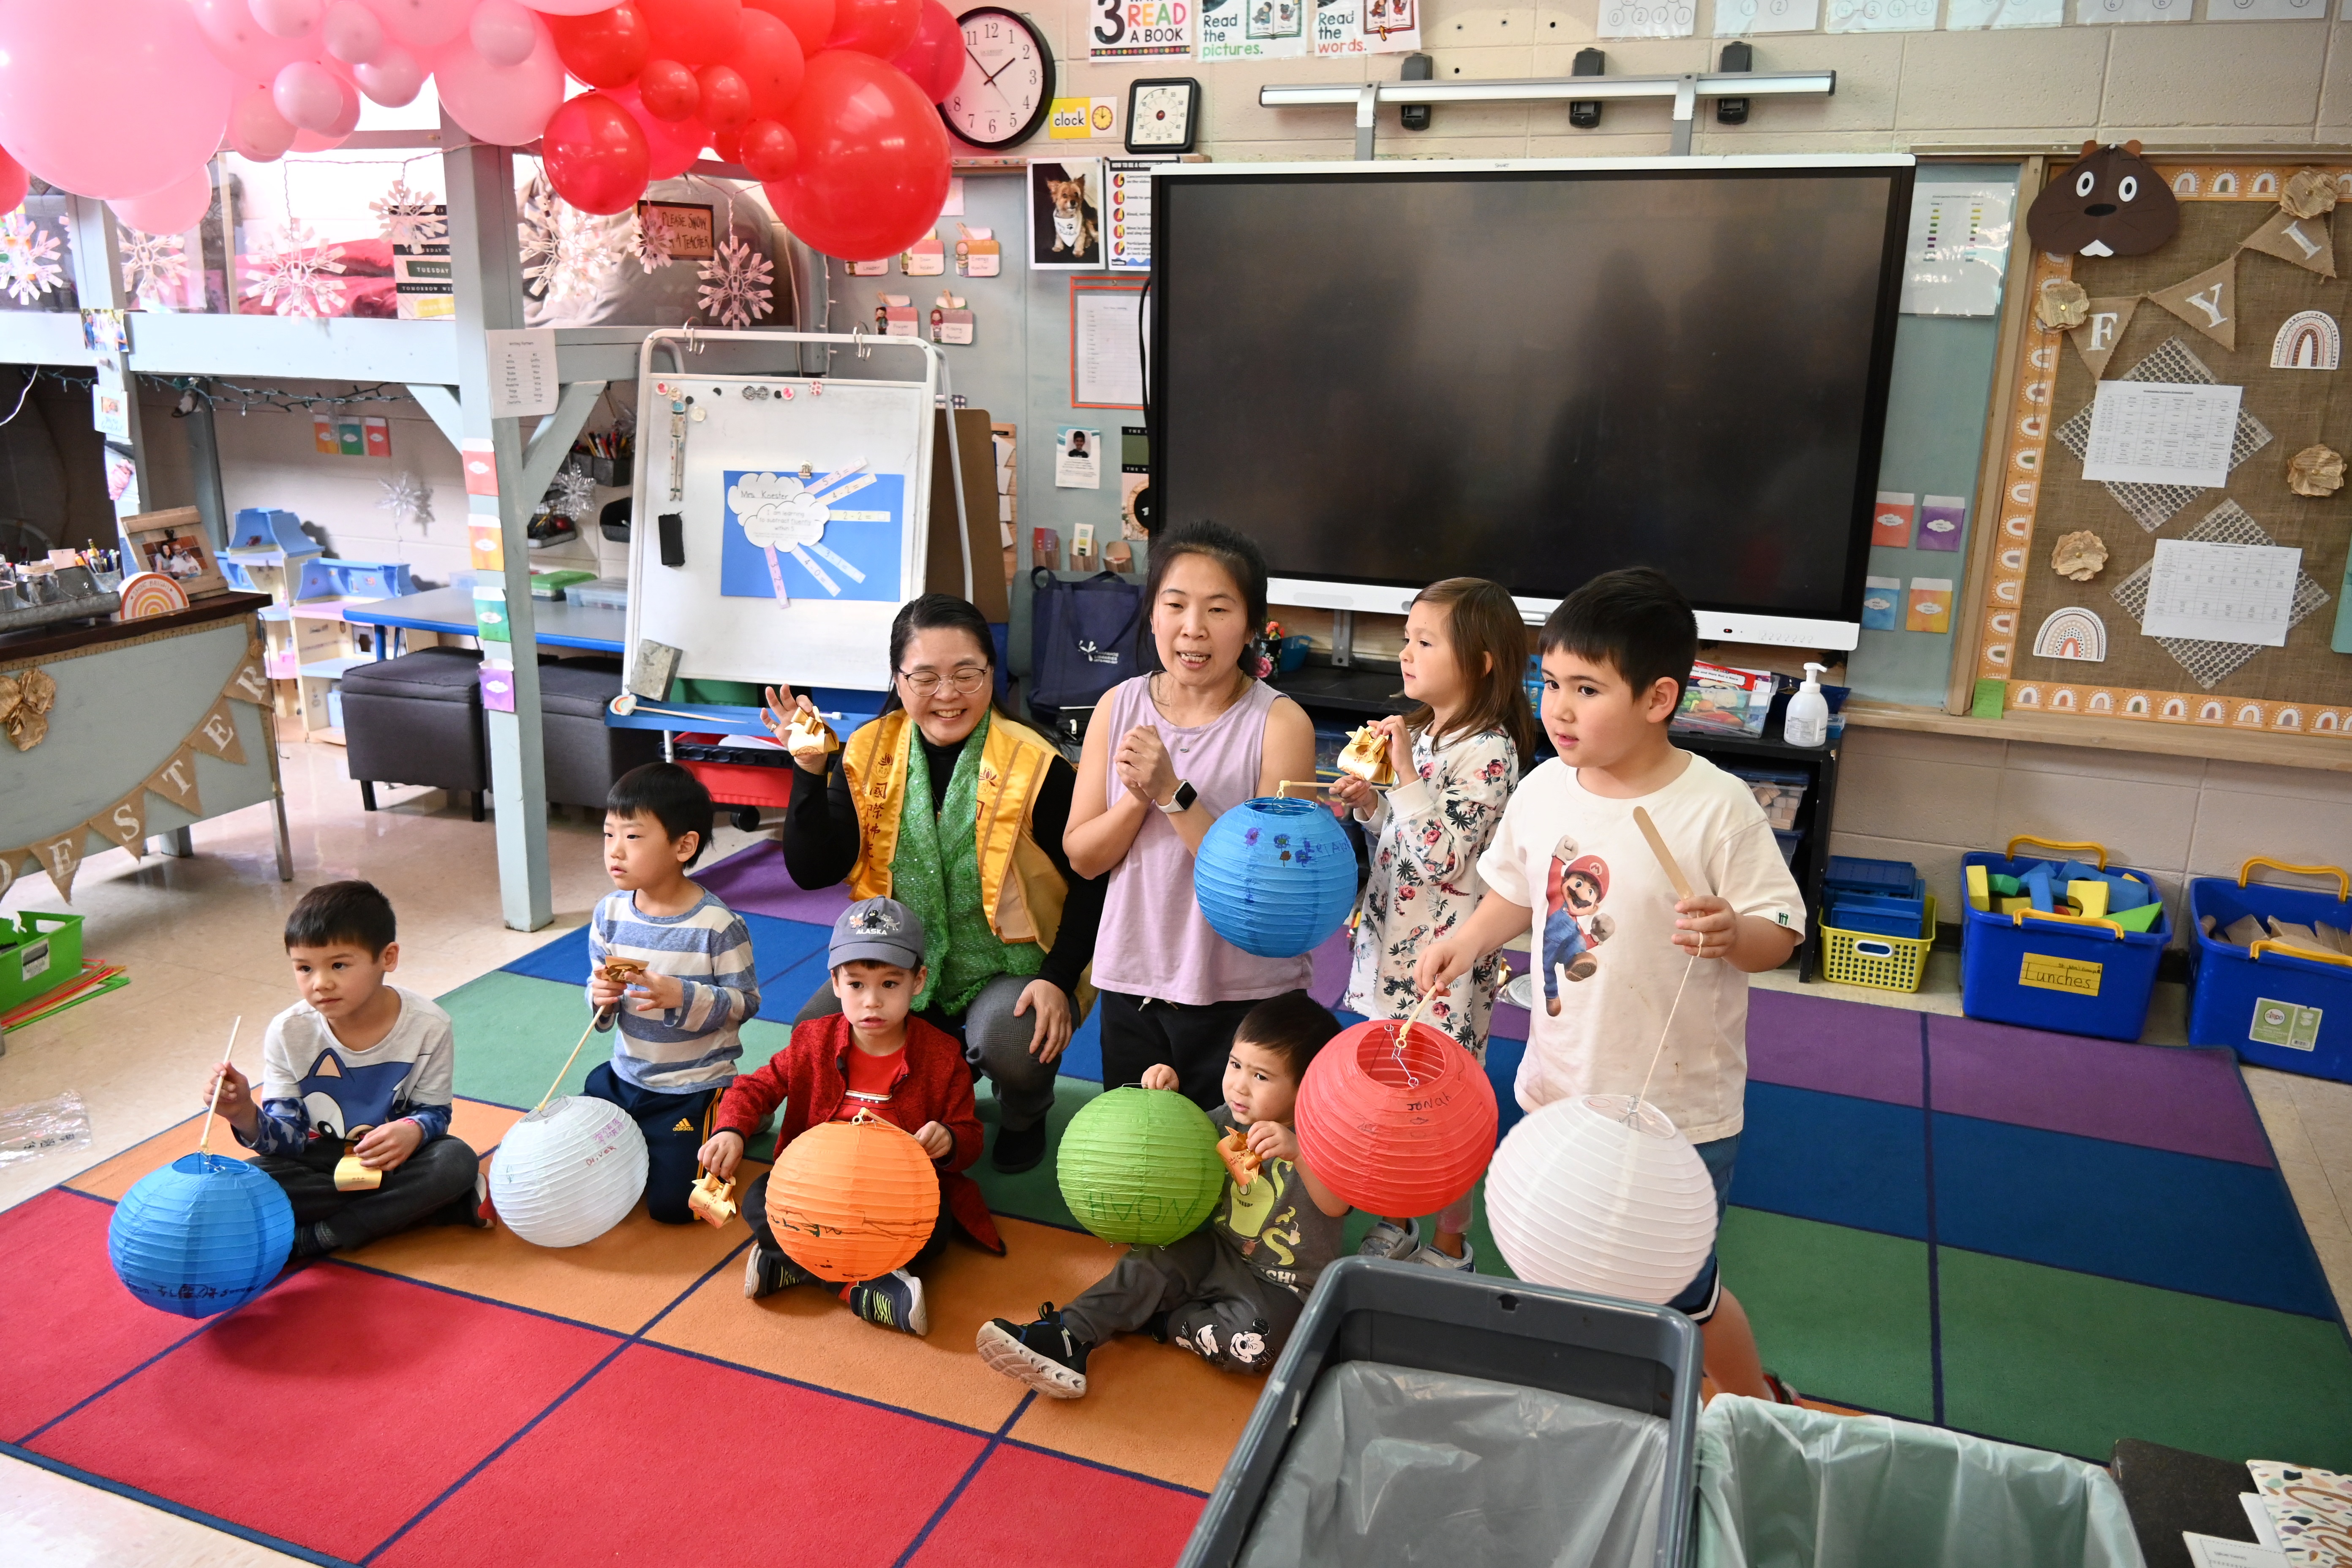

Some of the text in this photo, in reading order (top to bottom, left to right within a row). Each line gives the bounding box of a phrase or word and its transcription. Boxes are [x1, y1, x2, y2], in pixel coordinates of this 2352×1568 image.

[1128, 3, 1186, 27] READ
[1204, 14, 1237, 29] Read
[1318, 11, 1354, 26] Read
[1636, 11, 1643, 22] 2
[1094, 0, 1125, 45] 3
[985, 23, 999, 38] 12
[1009, 29, 1015, 44] 1
[1130, 28, 1183, 43] A BOOK
[1204, 30, 1225, 42] the
[1318, 27, 1341, 39] the
[966, 31, 977, 45] 11
[1023, 44, 1030, 59] 2
[1203, 43, 1263, 58] pictures.
[1318, 39, 1367, 53] words.
[1029, 69, 1037, 84] 3
[954, 97, 961, 111] 8
[1023, 95, 1030, 109] 4
[968, 114, 975, 128] 7
[1010, 113, 1017, 127] 5
[1054, 111, 1084, 126] clock
[989, 119, 996, 133] 6
[662, 212, 687, 227] PLEASE
[682, 234, 711, 250] TEACHER
[761, 490, 789, 500] Koester
[845, 485, 851, 494] 2
[843, 511, 848, 520] 2
[858, 512, 862, 520] 2
[825, 550, 830, 558] 3
[2025, 962, 2091, 989] Lunches
